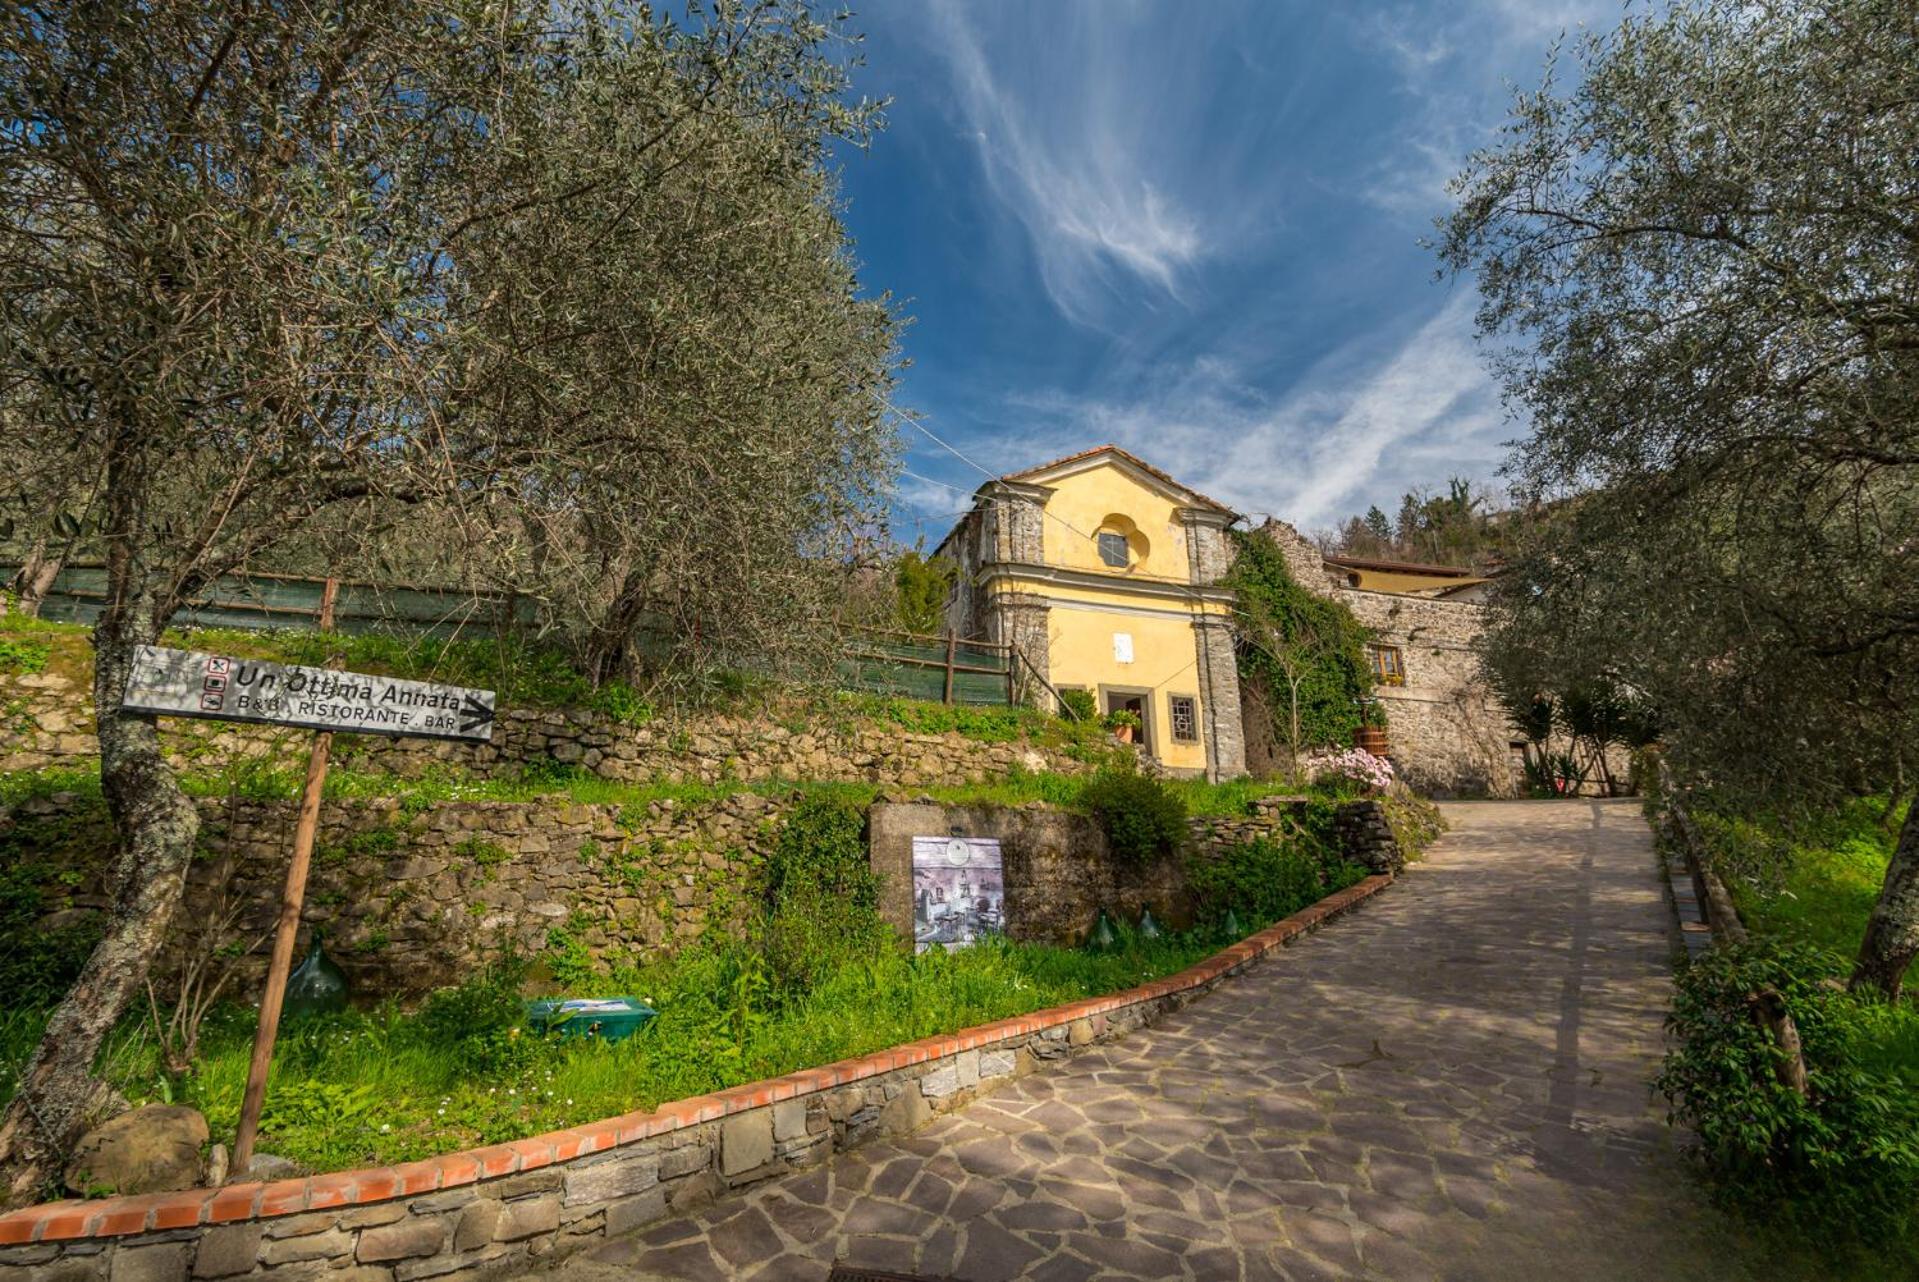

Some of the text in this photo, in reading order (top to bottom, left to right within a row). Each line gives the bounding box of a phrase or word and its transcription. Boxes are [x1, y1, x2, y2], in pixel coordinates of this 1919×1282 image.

[238, 695, 455, 730] B&B RISTORANTE BAR
[381, 685, 460, 711] Annata
